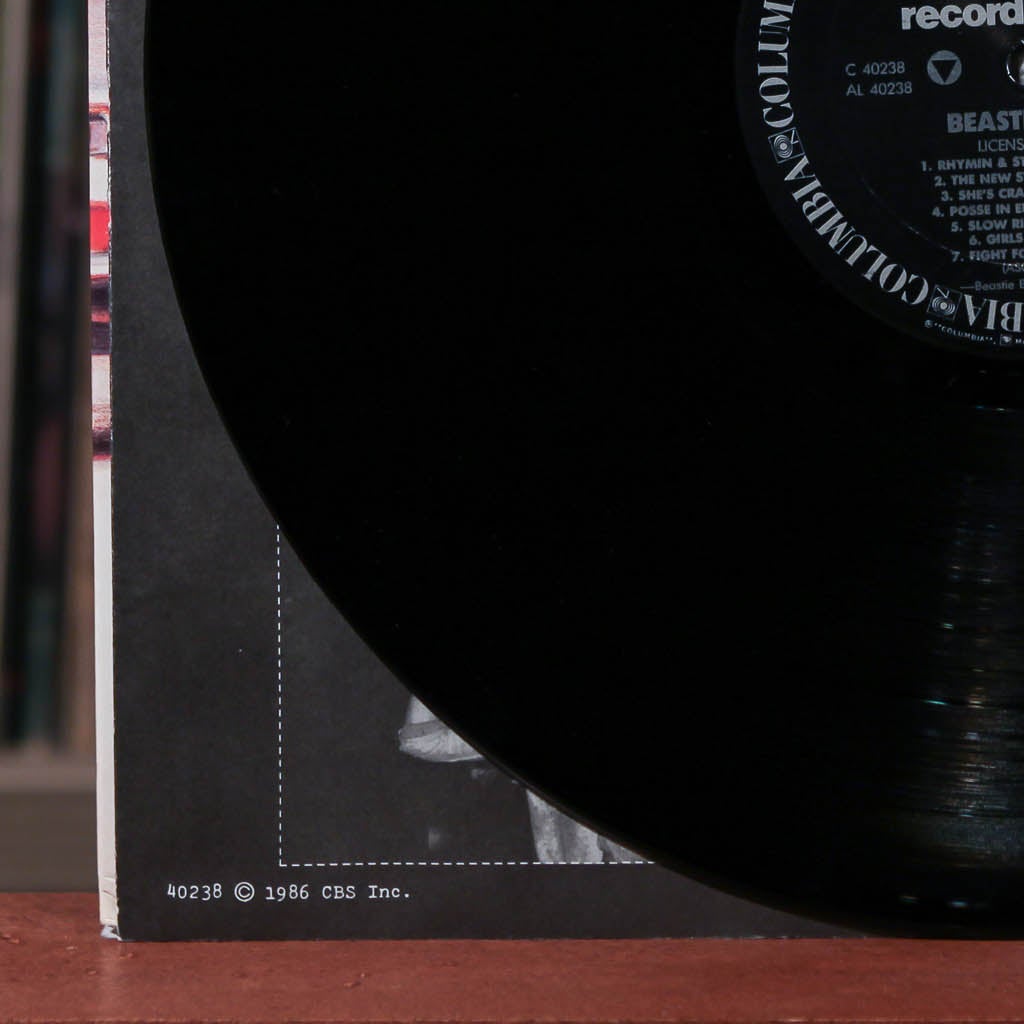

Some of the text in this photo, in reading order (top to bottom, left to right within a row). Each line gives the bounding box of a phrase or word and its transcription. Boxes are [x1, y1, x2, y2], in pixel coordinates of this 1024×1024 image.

[846, 62, 905, 76] C 40238
[846, 83, 912, 96] AL 40238
[921, 161, 932, 171] 1.
[937, 159, 992, 170] RHYMIN
[997, 158, 1007, 168] &
[935, 176, 946, 186] 2.
[951, 175, 974, 185] THE
[980, 173, 1011, 184] NEW
[941, 191, 953, 201] 3.
[958, 189, 994, 200] SHE'S
[931, 207, 944, 217] 4.
[950, 205, 990, 216] POSSE
[996, 204, 1010, 214] IN
[784, 155, 928, 305] COLUMBIA
[951, 222, 962, 232] 5.
[968, 220, 1006, 231] SLOW
[969, 236, 981, 246] 6.
[986, 233, 1023, 244] GIRLS
[951, 251, 964, 262] 7.
[969, 249, 1006, 261] FIGHT
[167, 883, 223, 901] 40238
[265, 884, 309, 902] 1986
[322, 885, 356, 900] CBS
[368, 884, 410, 899] Inc.
